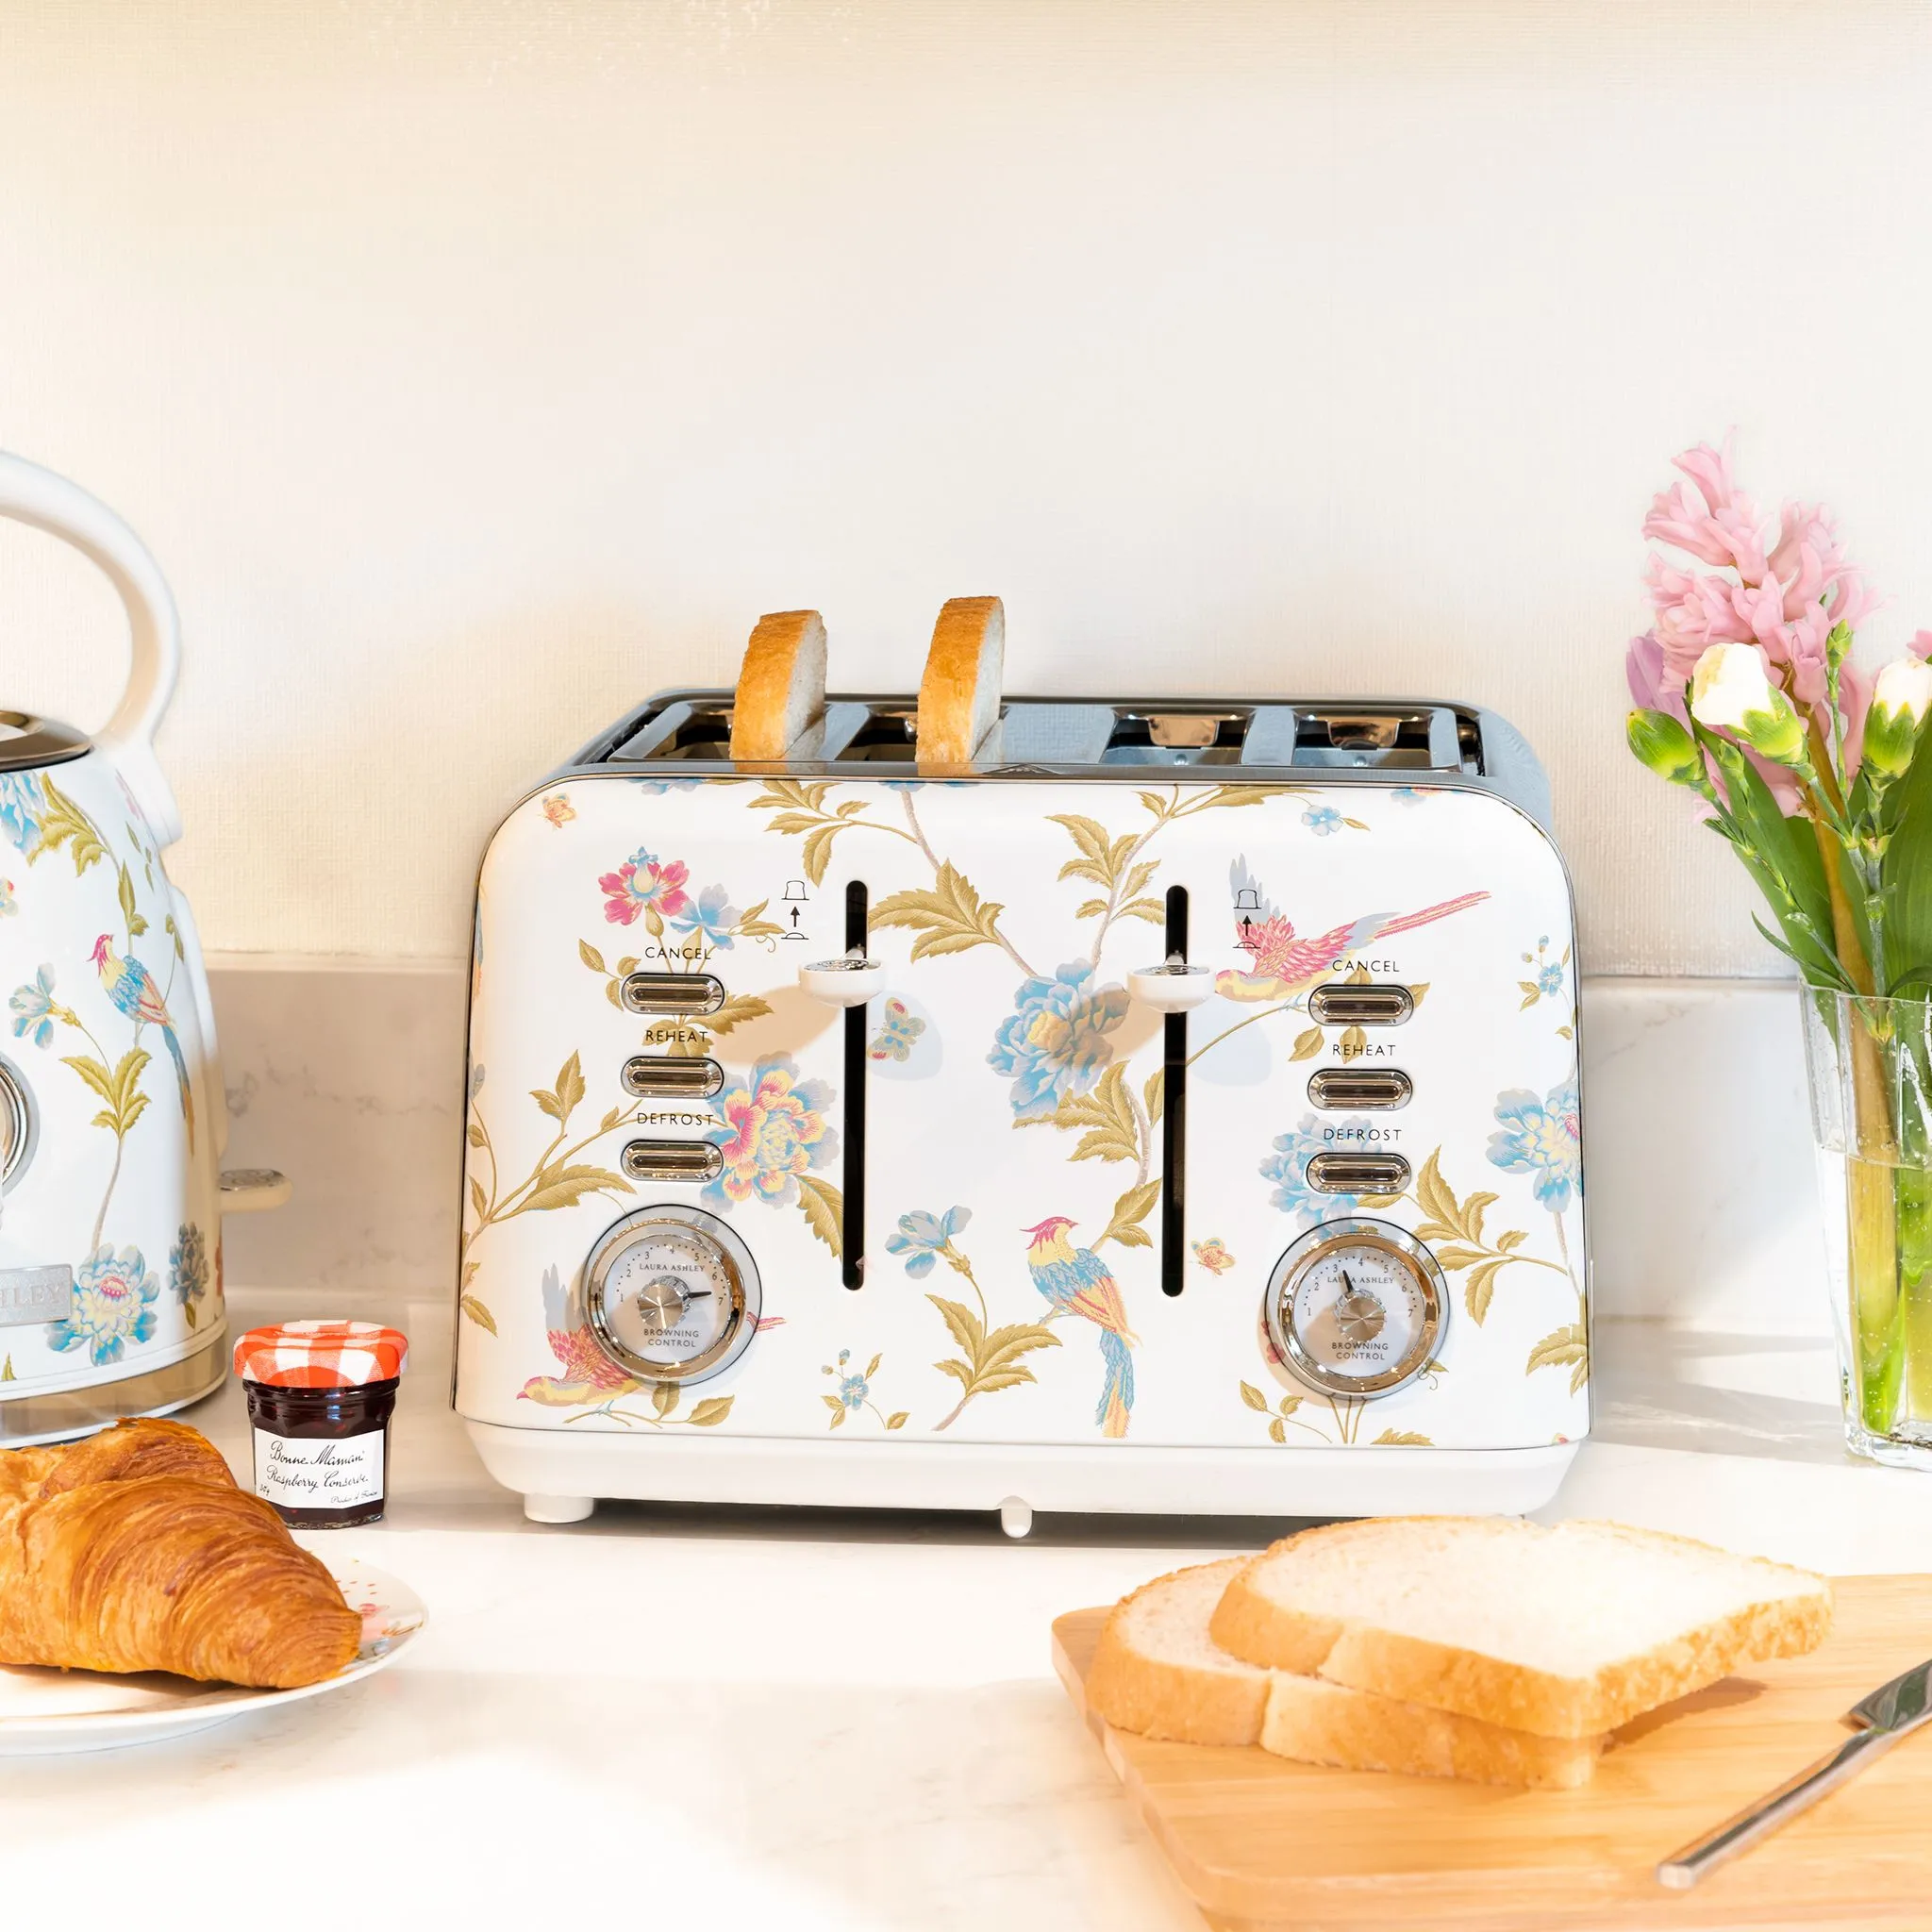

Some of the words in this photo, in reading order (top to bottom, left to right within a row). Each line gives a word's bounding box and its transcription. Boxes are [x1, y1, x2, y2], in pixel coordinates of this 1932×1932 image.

[644, 946, 712, 960] CANCEL
[1332, 959, 1400, 973] CANCEL
[645, 1029, 708, 1042] REHEAT
[1332, 1044, 1396, 1057] REHEAT
[637, 1112, 715, 1126] DEFROST
[1323, 1128, 1403, 1141] DEFROST
[644, 1251, 650, 1259] 3
[694, 1253, 700, 1261] 5
[1357, 1257, 1363, 1267] 4
[639, 1262, 667, 1271] LAURA
[670, 1264, 706, 1273] ASHLEY
[1333, 1264, 1339, 1273] 3
[1383, 1264, 1389, 1274] 5
[626, 1269, 632, 1278] 2
[712, 1272, 718, 1280] 6
[1327, 1275, 1357, 1284] LAUA
[1359, 1275, 1394, 1284] ASHLEY
[1314, 1282, 1320, 1291] 2
[1401, 1284, 1407, 1292] 6
[718, 1297, 724, 1306] 7
[643, 1328, 700, 1338] BROWNING
[648, 1338, 696, 1348] CONTROL
[1331, 1341, 1389, 1350] BROWNING
[1336, 1352, 1385, 1360] CONTROL
[270, 1440, 308, 1465] Bonne
[266, 1464, 318, 1493] Raspberry
